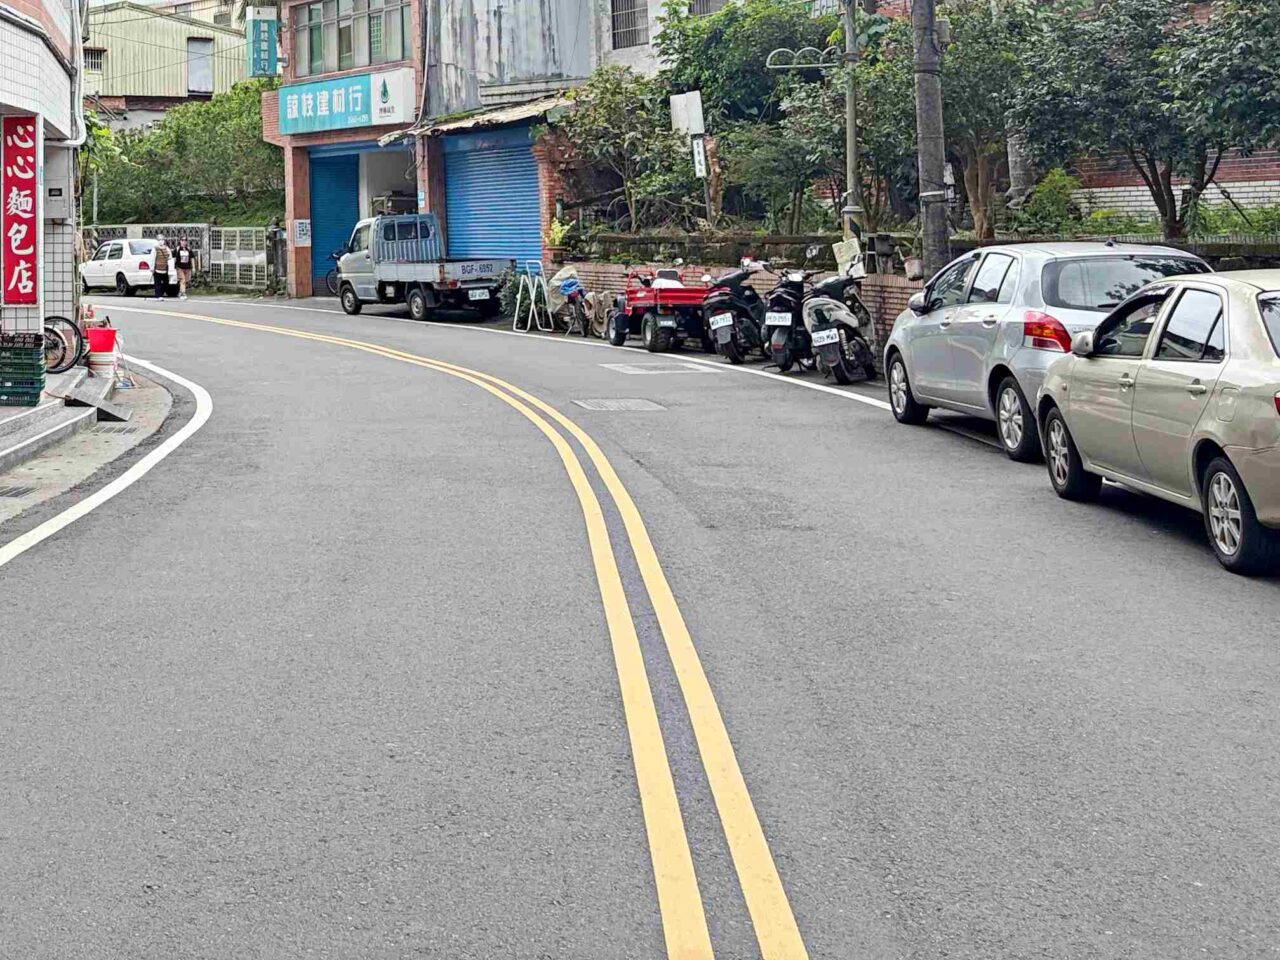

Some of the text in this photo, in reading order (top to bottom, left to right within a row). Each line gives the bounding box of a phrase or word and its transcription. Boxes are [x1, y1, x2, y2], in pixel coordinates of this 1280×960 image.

[6, 125, 36, 295] 心心麵包店
